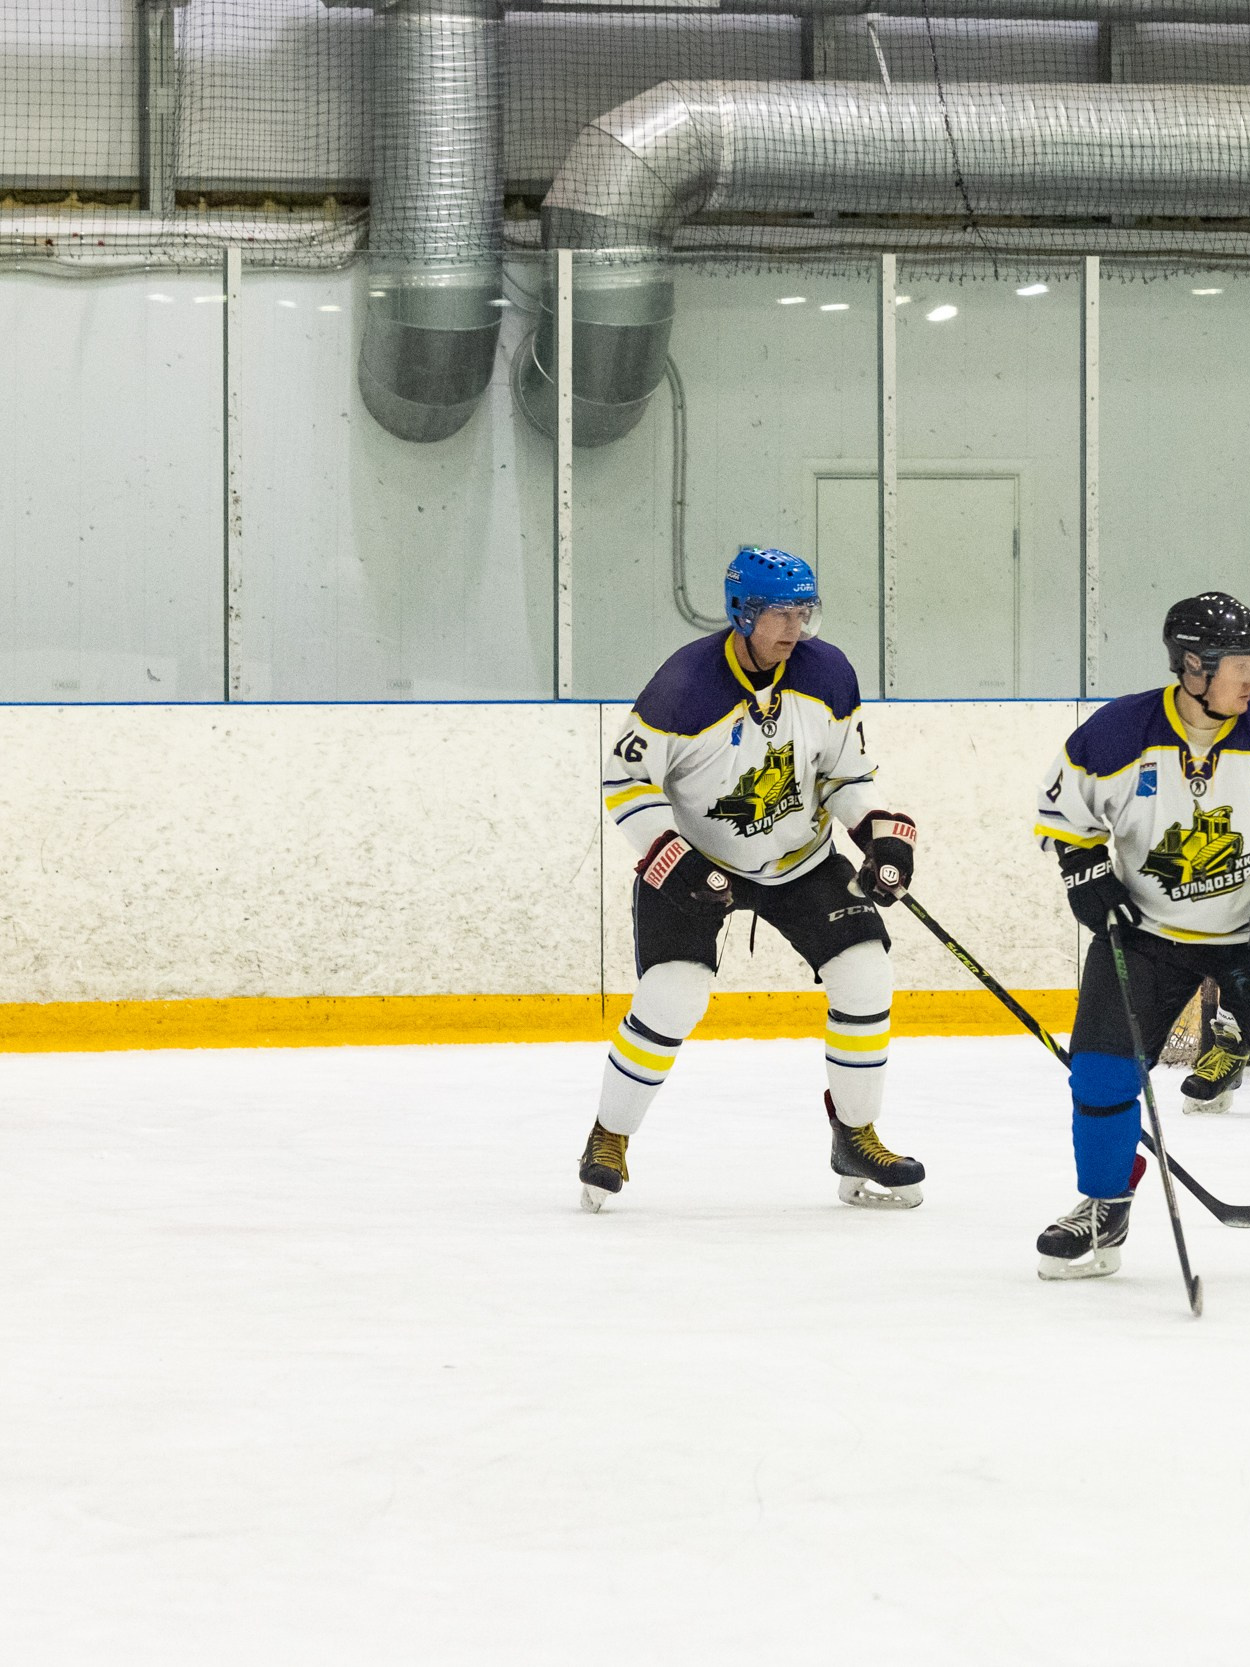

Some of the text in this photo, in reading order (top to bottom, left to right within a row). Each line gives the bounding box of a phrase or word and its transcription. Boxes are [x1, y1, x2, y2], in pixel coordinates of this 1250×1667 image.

[613, 730, 648, 763] 16
[646, 841, 686, 889] RRIOR
[828, 905, 876, 923] CCM
[945, 941, 979, 973] SUPER
